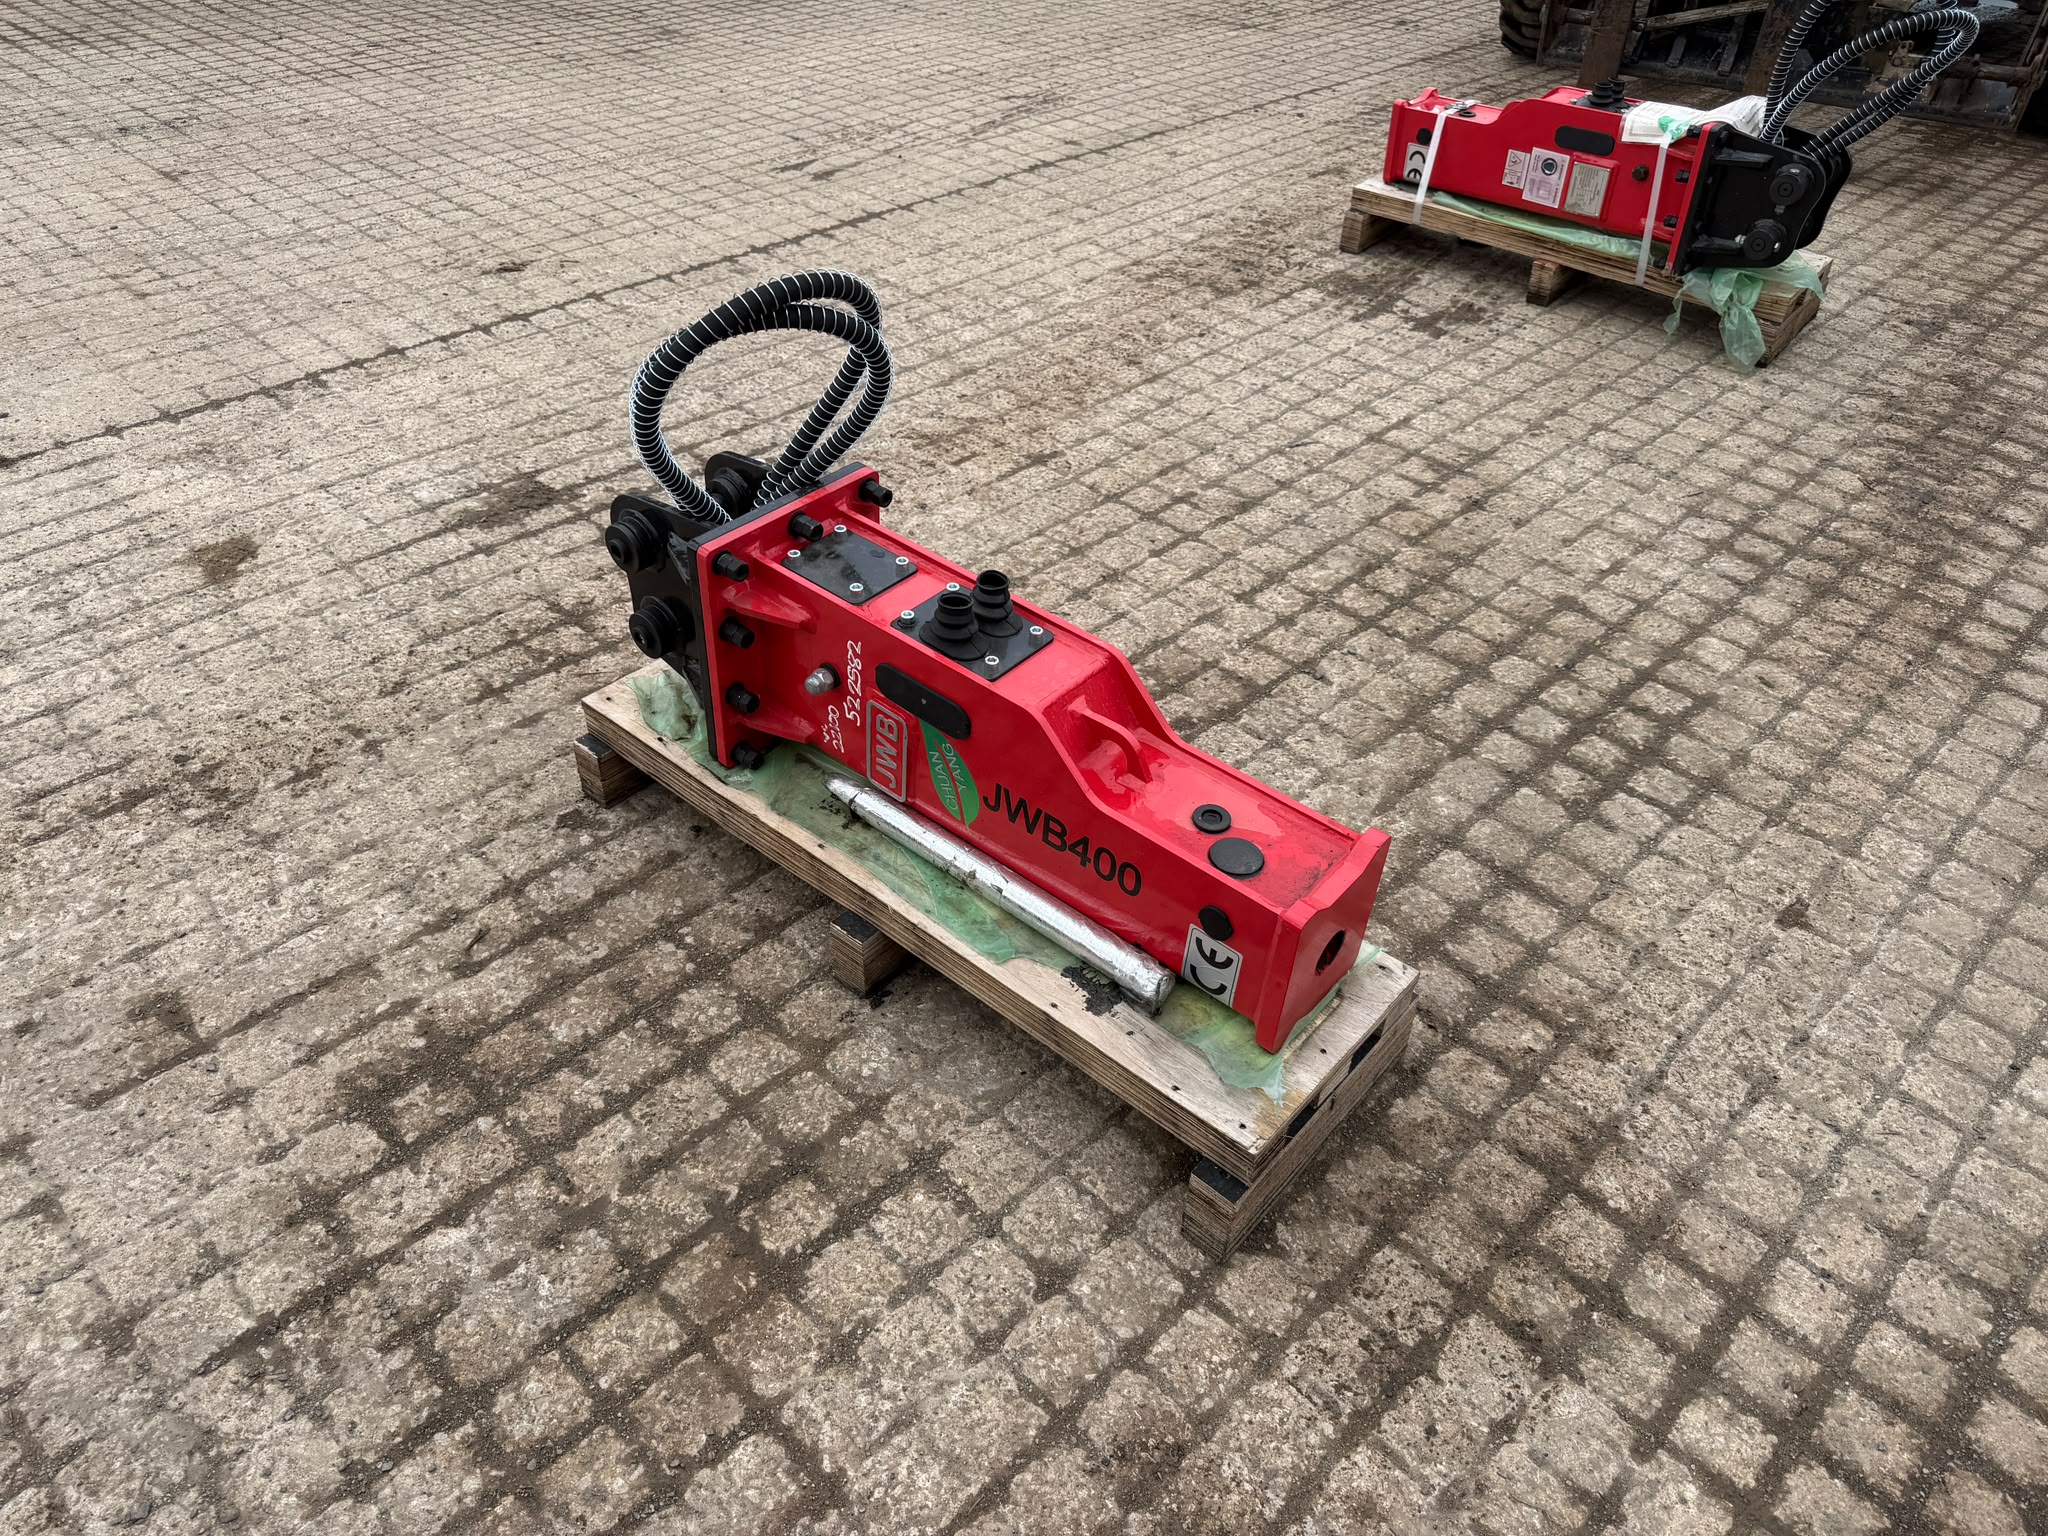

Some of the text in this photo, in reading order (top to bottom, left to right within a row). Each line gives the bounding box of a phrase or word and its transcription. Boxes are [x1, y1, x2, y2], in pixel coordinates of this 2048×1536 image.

[876, 714, 899, 789] JWB
[929, 751, 959, 810] CHUAN
[942, 743, 967, 793] YANG
[983, 783, 1142, 897] JWB400
[1190, 936, 1234, 996] CE
